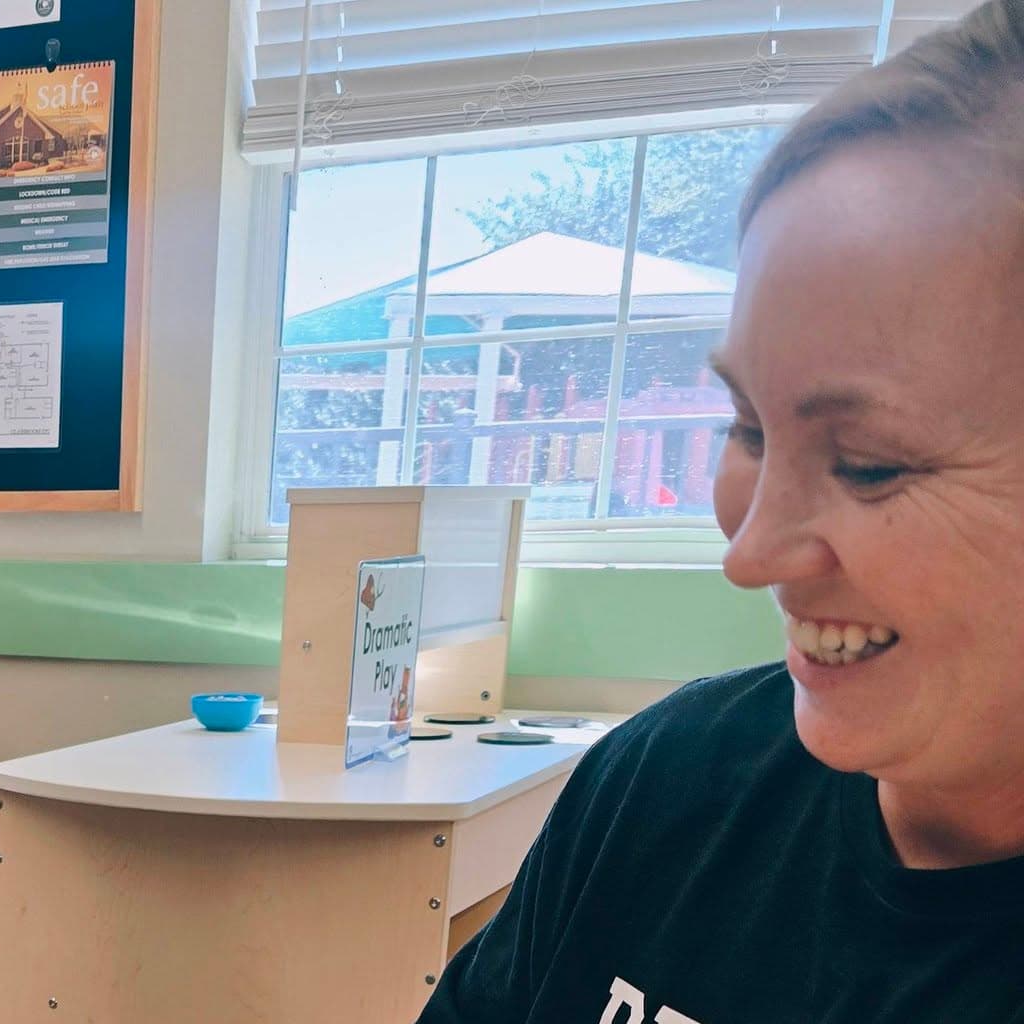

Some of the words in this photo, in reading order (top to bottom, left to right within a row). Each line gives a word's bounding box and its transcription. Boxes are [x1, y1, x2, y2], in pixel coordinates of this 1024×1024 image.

[37, 74, 98, 110] safe
[363, 619, 412, 655] Dramatic
[374, 660, 398, 696] Play
